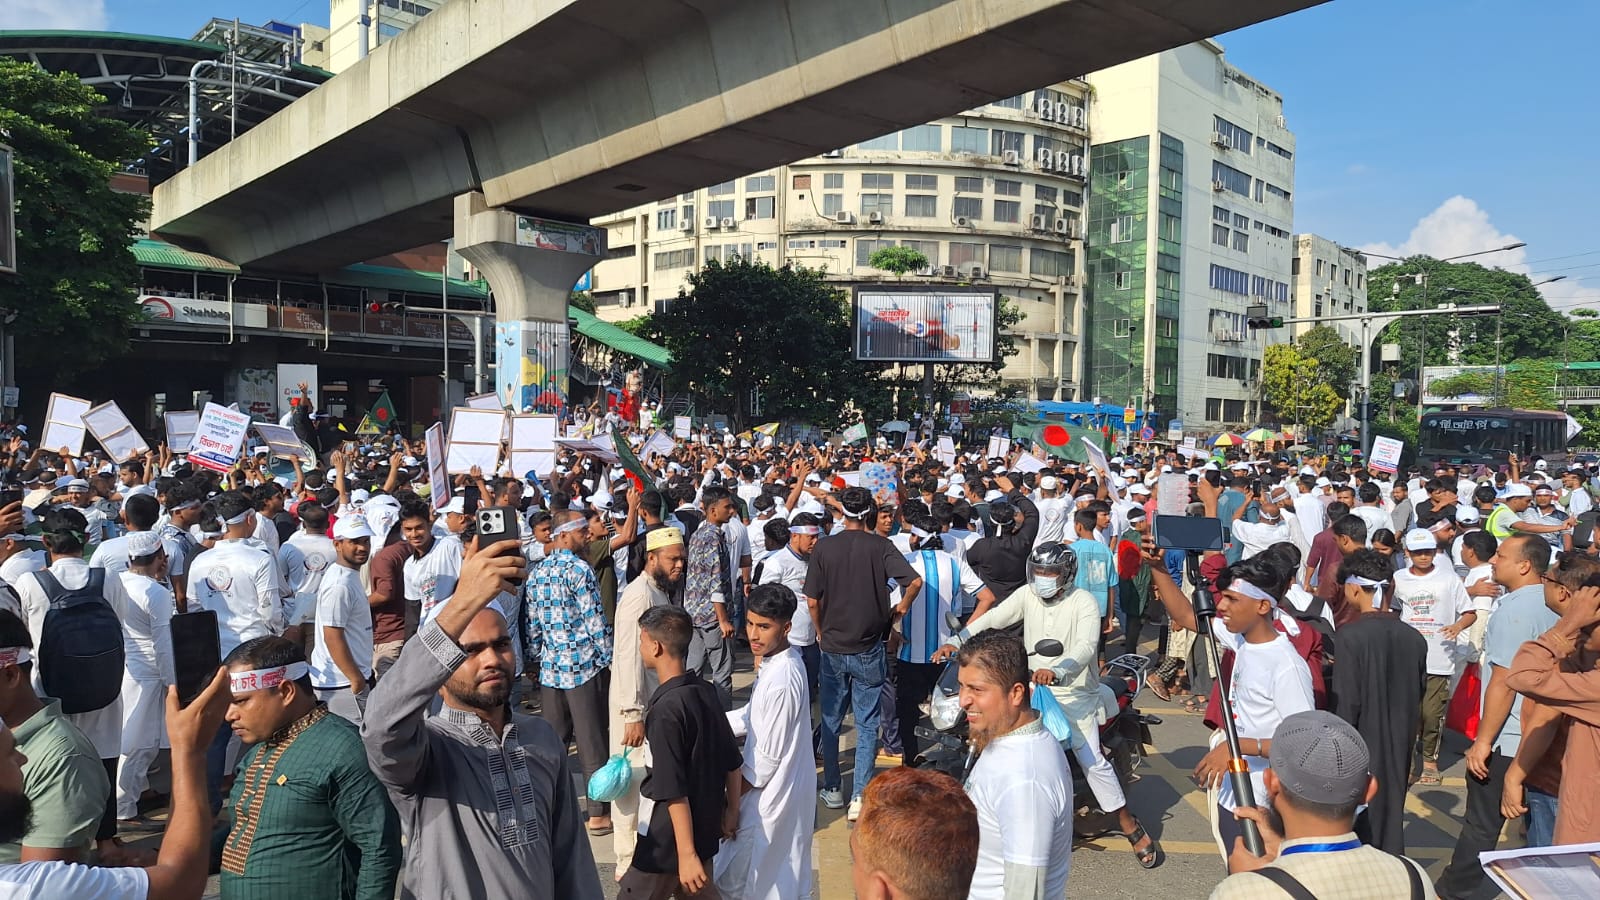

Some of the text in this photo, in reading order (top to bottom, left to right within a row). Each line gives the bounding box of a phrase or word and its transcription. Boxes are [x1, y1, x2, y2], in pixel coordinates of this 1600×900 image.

[182, 306, 230, 320] Shahbag
[199, 435, 234, 455] বিভাগ চাই
[241, 673, 258, 689] চাই
